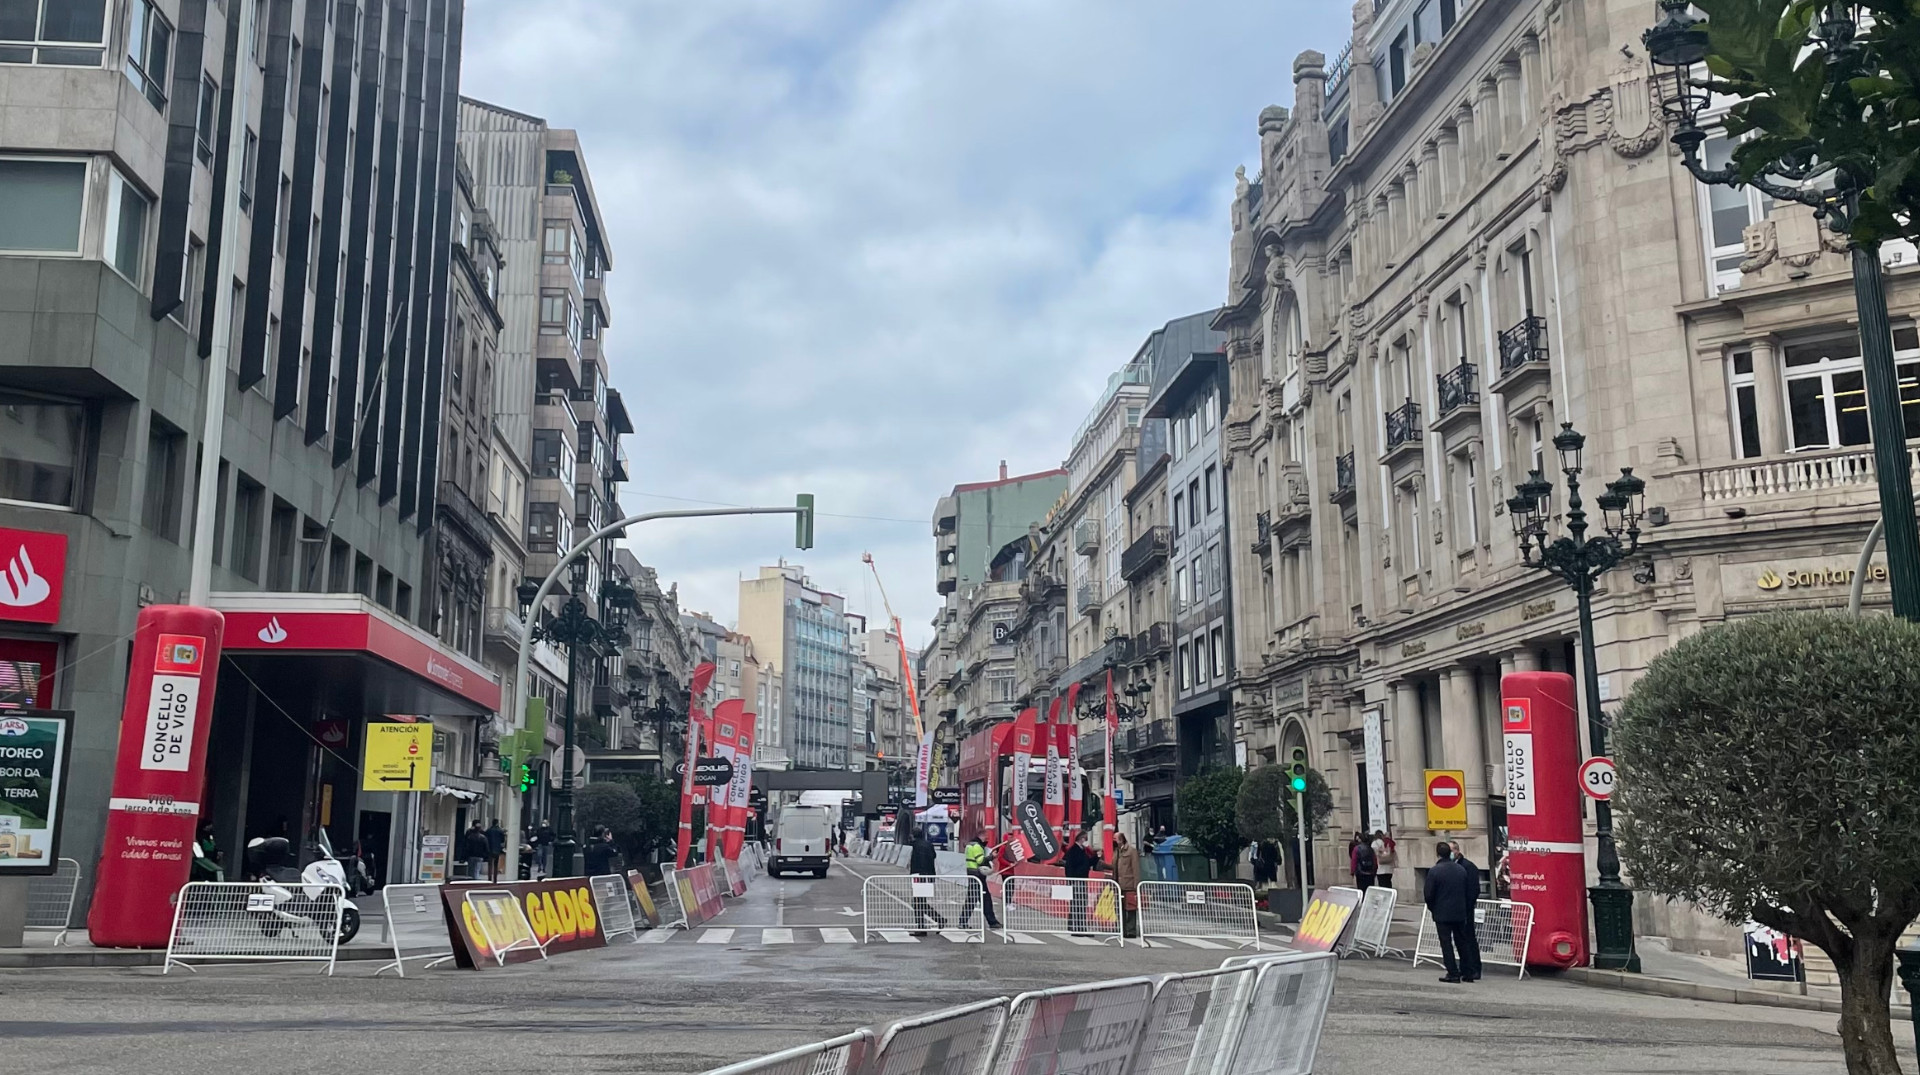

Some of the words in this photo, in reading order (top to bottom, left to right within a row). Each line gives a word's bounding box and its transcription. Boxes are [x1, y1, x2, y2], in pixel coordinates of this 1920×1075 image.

[173, 693, 188, 731] VIGO
[0, 717, 25, 731] LARSA
[153, 683, 174, 762] CONCELLO
[380, 725, 419, 733] ATENCIÓN
[0, 747, 43, 759] TOREO
[169, 734, 183, 754] DE
[920, 744, 929, 781] YAMAHA
[1515, 748, 1524, 777] VIGO
[24, 768, 41, 778] DA
[730, 757, 741, 802] CONCELLO
[1506, 740, 1516, 808] CONCELLO
[1588, 771, 1613, 785] 30
[4, 787, 39, 799] TERRA
[737, 787, 744, 798] DE
[1516, 783, 1526, 800] DE
[157, 805, 170, 815] de
[1033, 816, 1054, 854] LEXUS
[526, 887, 596, 944] GADIS
[1298, 899, 1350, 945] GADIS
